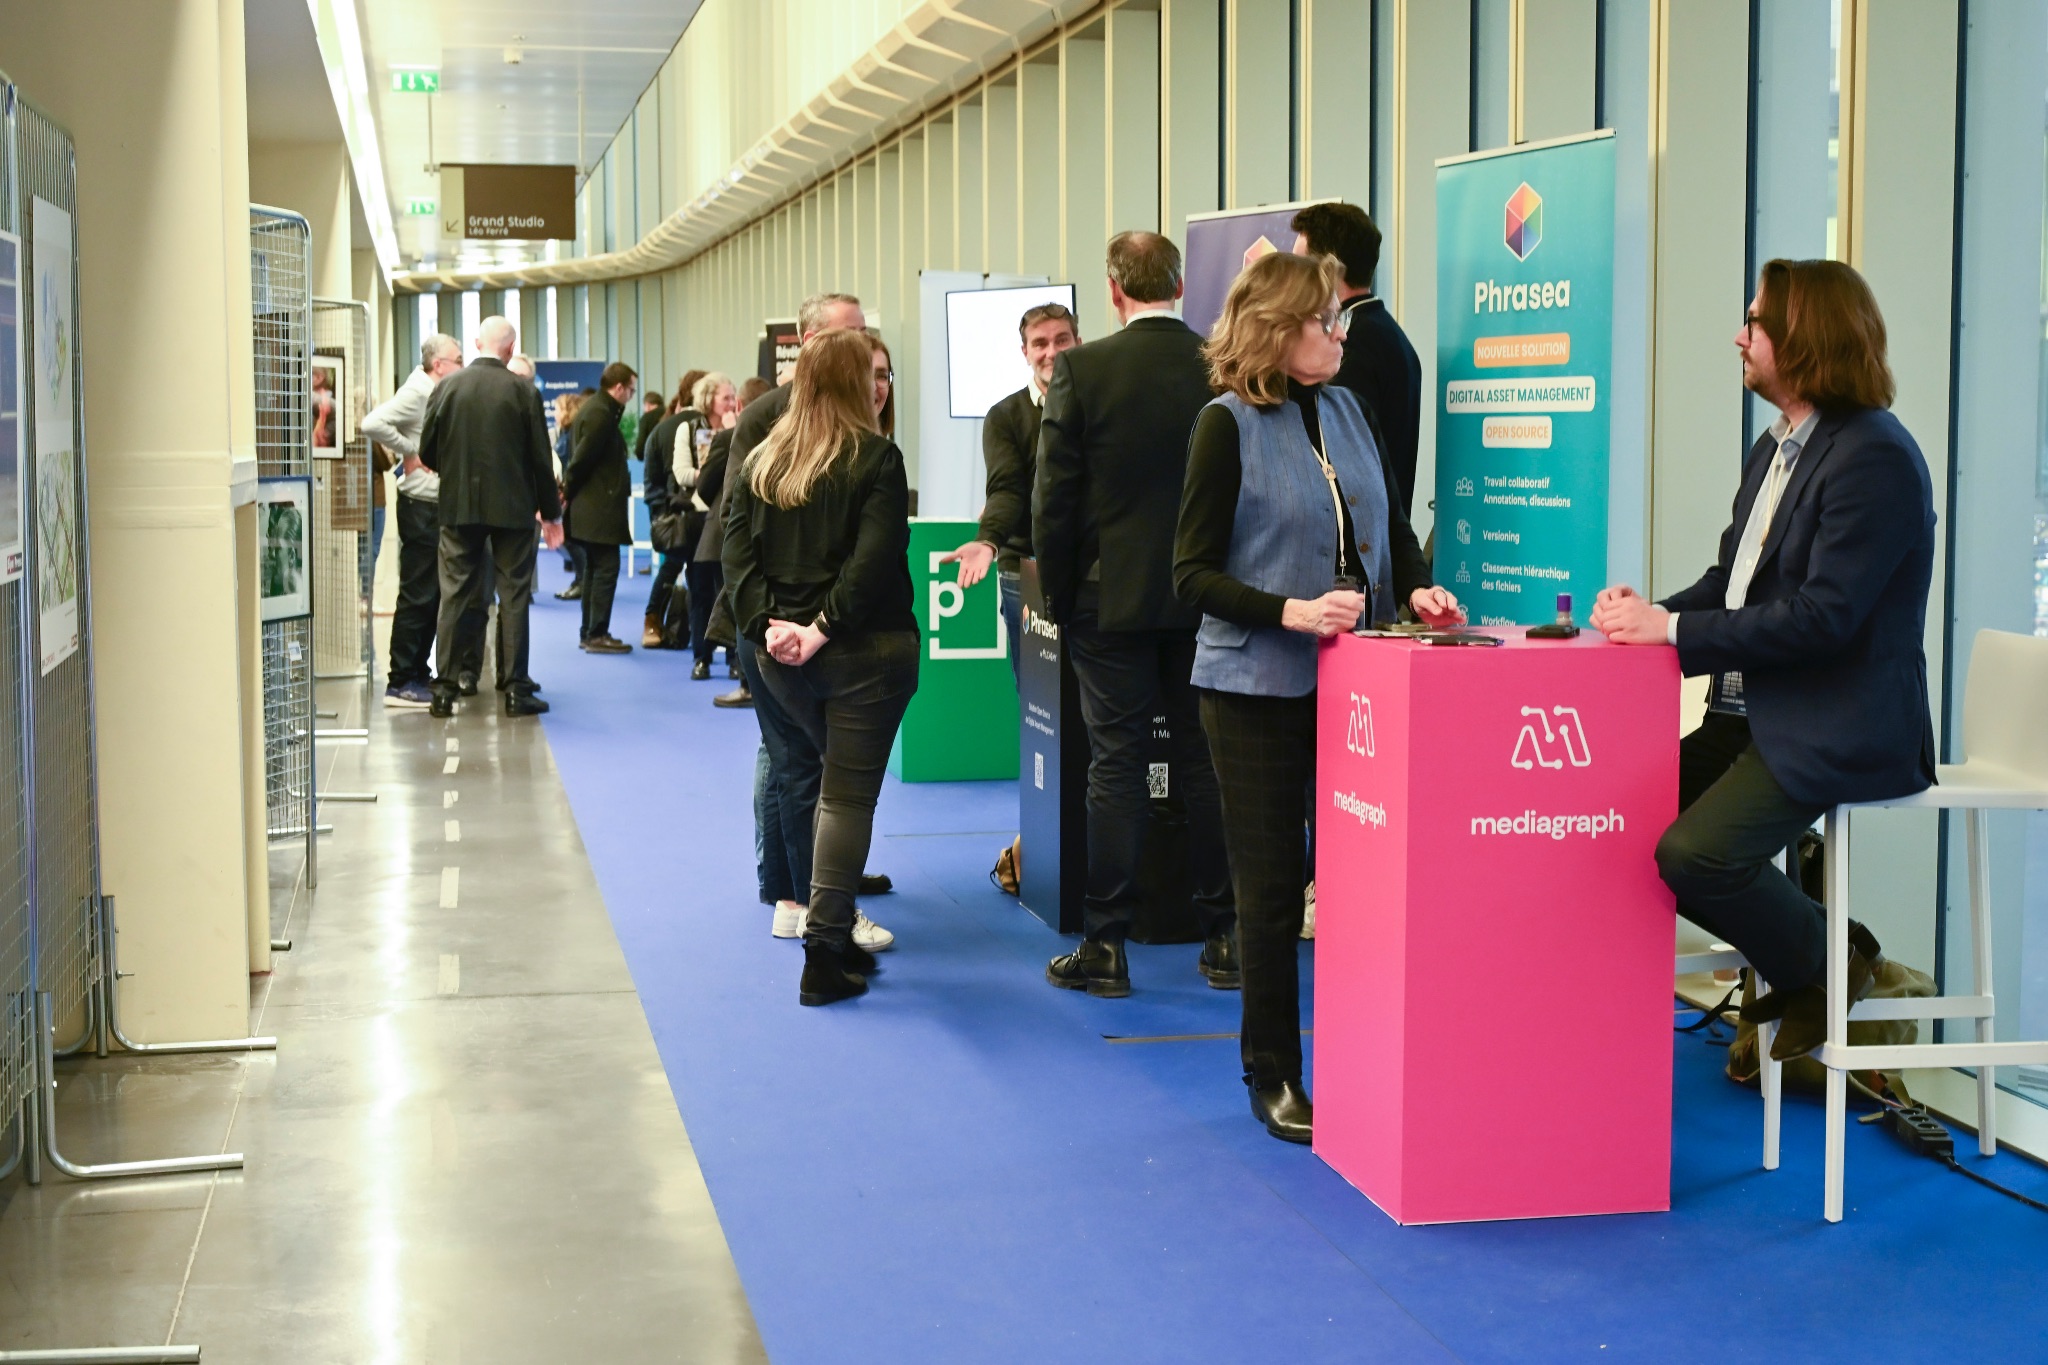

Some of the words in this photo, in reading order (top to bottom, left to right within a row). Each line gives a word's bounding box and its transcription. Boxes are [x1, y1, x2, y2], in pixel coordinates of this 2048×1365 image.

[469, 215, 504, 227] Grand
[508, 215, 545, 228] Studio
[469, 227, 484, 236] Léo
[486, 226, 509, 236] Ferré
[1475, 279, 1570, 314] Phrasea
[1477, 344, 1520, 359] NOUVELLE
[1522, 342, 1566, 357] SOLUTION
[1449, 389, 1485, 404] DIGITAL
[1487, 388, 1515, 402] ASSET
[1517, 386, 1591, 402] MANAGEMENT
[1486, 426, 1509, 439] OPEN
[1511, 426, 1548, 439] SOURCE
[1483, 476, 1507, 488] Travail
[1508, 476, 1550, 489] collaboratif
[1483, 493, 1528, 507] Annotations,
[1529, 494, 1571, 508] discussions
[1482, 530, 1520, 545] Versioning
[1482, 562, 1522, 576] Classement
[1523, 564, 1570, 581] hiérarchique
[1481, 580, 1494, 591] des
[1495, 579, 1521, 593] fichiers
[1030, 609, 1058, 641] Phrasea
[1481, 615, 1516, 627] Workflow
[1334, 790, 1386, 830] mediagraph
[1471, 808, 1625, 840] mediagraph
